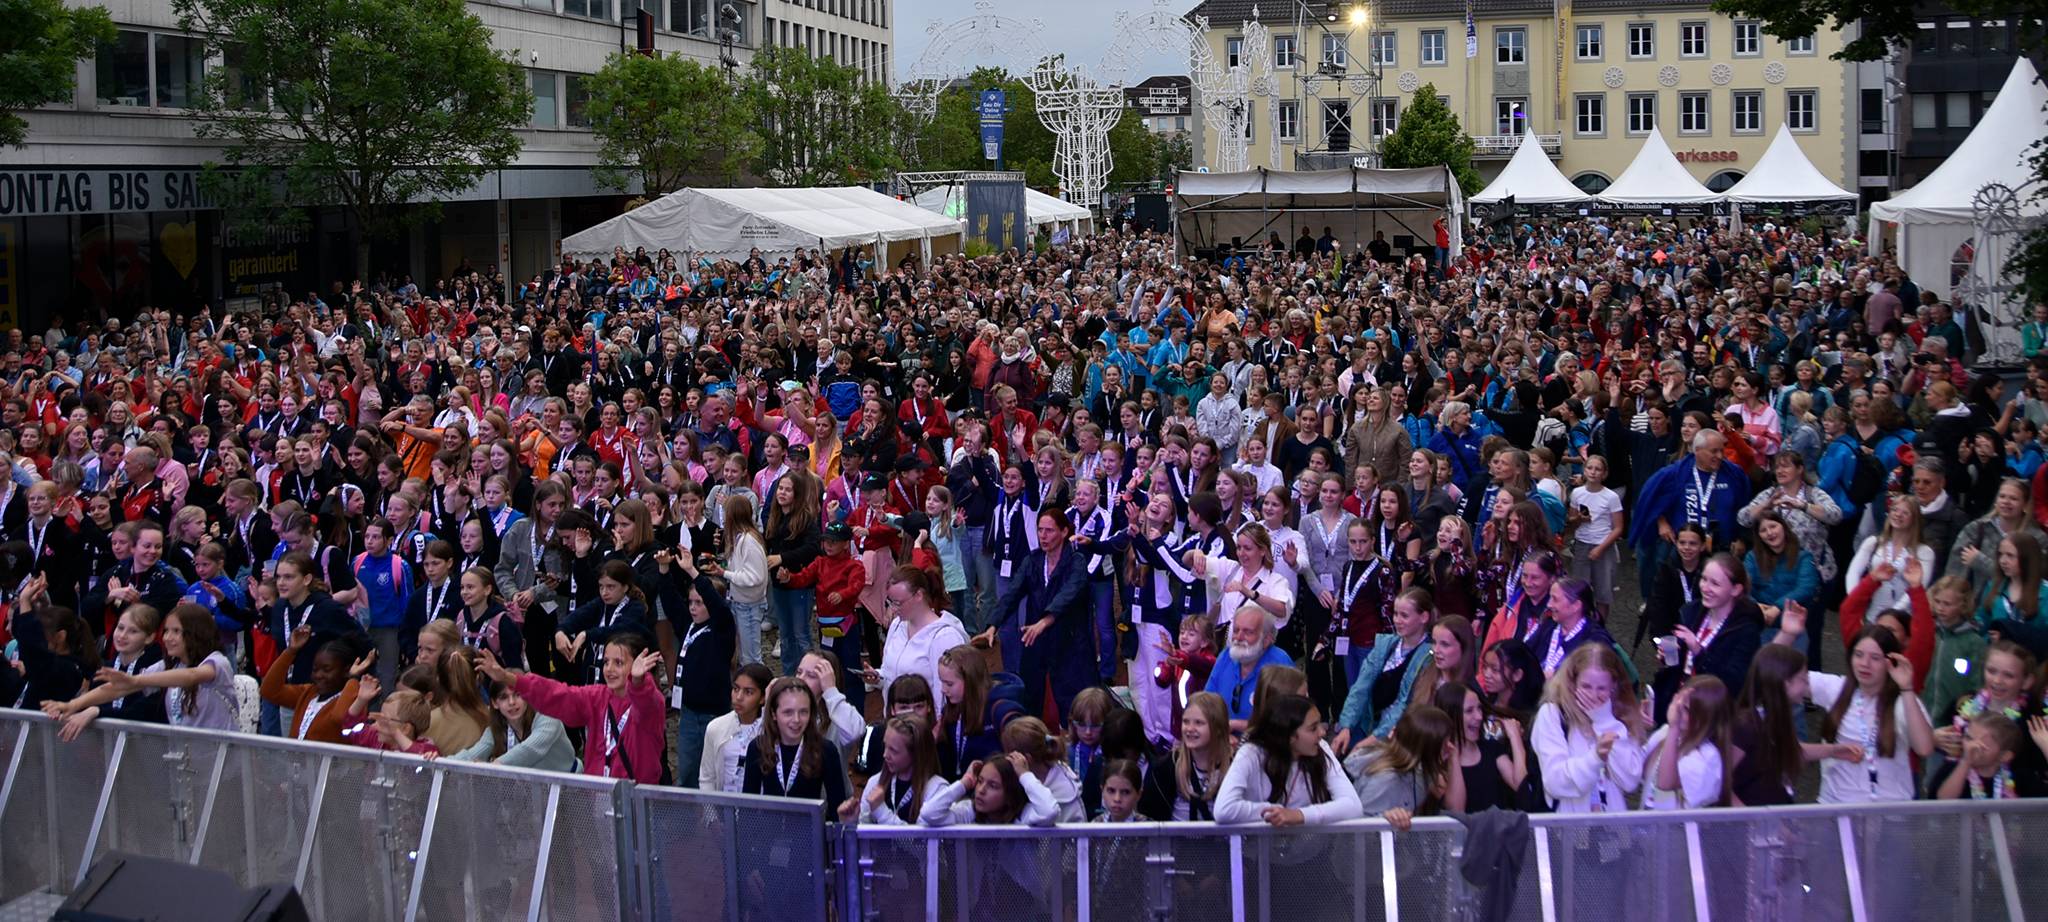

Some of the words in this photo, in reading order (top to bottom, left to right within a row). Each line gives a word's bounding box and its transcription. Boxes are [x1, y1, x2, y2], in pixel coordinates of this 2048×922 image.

[1674, 148, 1739, 163] arkasse
[109, 172, 150, 211] BIS
[228, 248, 299, 283] garantiert!
